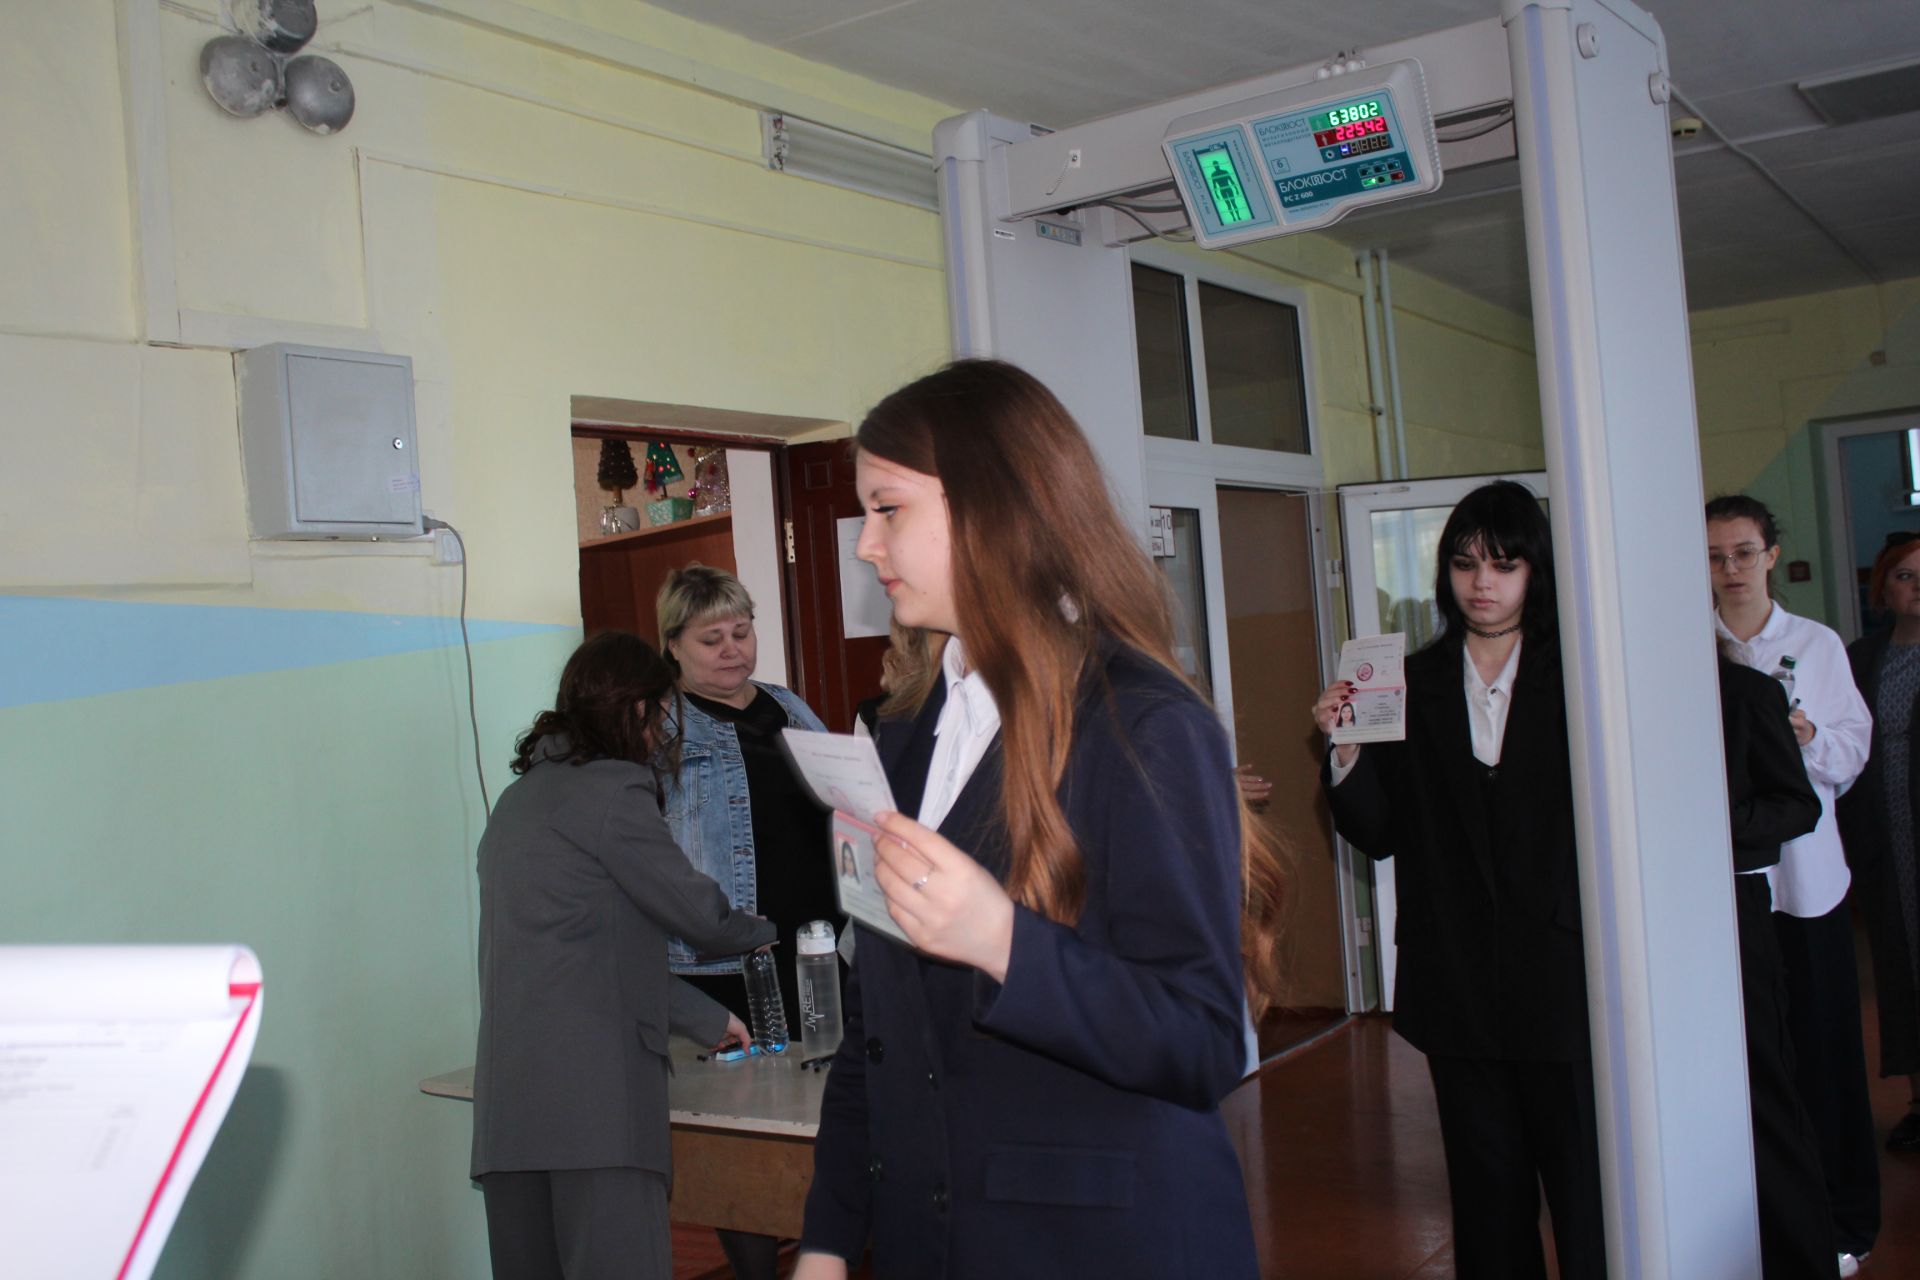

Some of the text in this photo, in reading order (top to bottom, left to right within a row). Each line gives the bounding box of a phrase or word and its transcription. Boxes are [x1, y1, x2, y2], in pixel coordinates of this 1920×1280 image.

[1329, 102, 1378, 126] 63802
[1335, 117, 1385, 141] 22542
[1278, 168, 1347, 193] БЛОКПОСТ
[1300, 190, 1314, 200] 600
